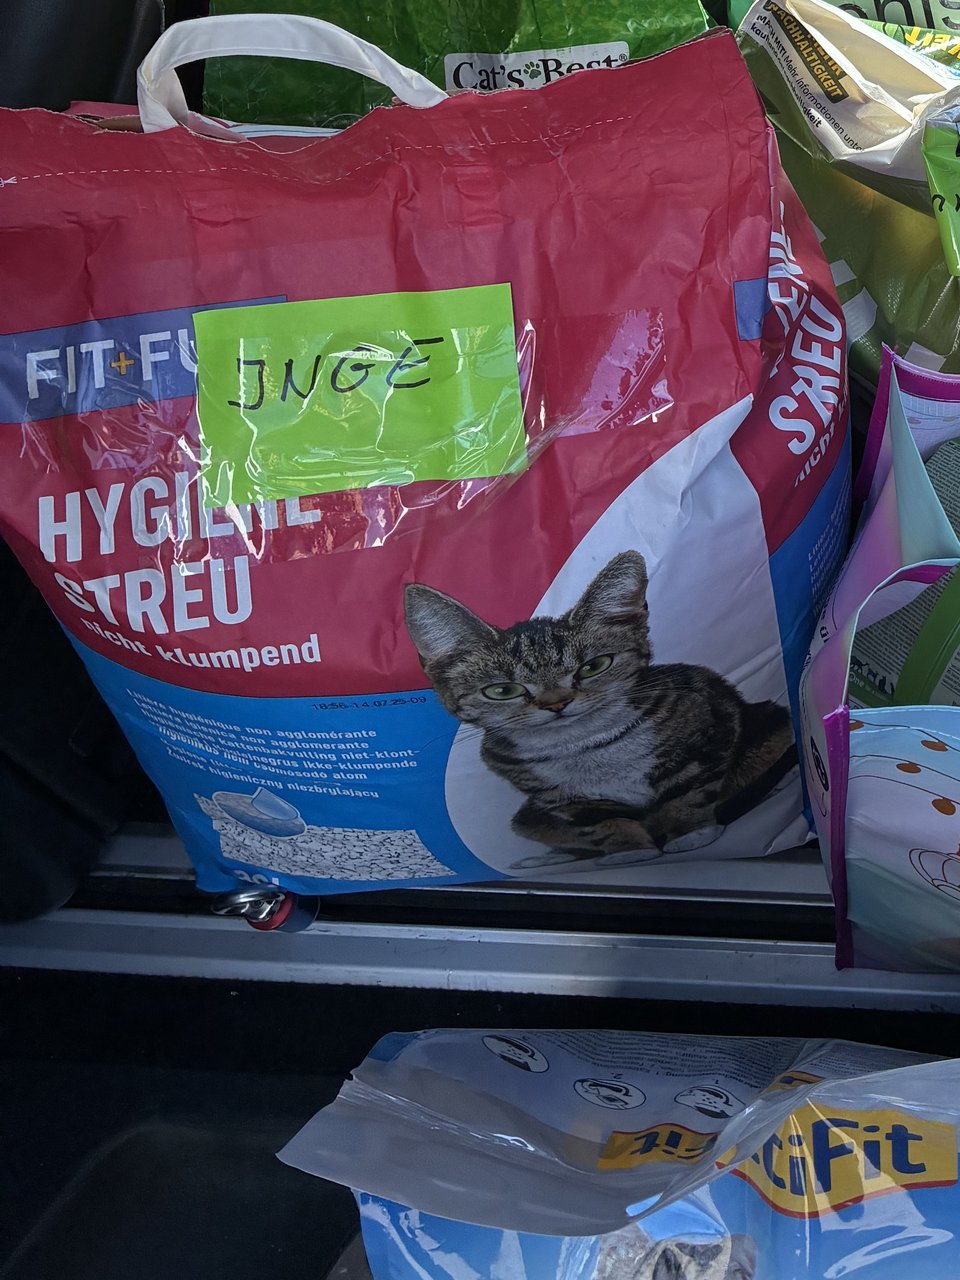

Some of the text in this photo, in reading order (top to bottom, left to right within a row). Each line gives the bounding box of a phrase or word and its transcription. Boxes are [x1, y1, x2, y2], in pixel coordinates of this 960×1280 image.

[452, 61, 525, 90] Cat's
[795, 77, 845, 135] Informationen
[54, 555, 253, 635] STREU
[80, 616, 322, 673] nicht klumpend
[240, 734, 266, 745] non
[270, 739, 370, 751] agglomerante
[245, 726, 272, 736] non
[276, 729, 377, 740] agglomérante
[332, 771, 368, 780] alom
